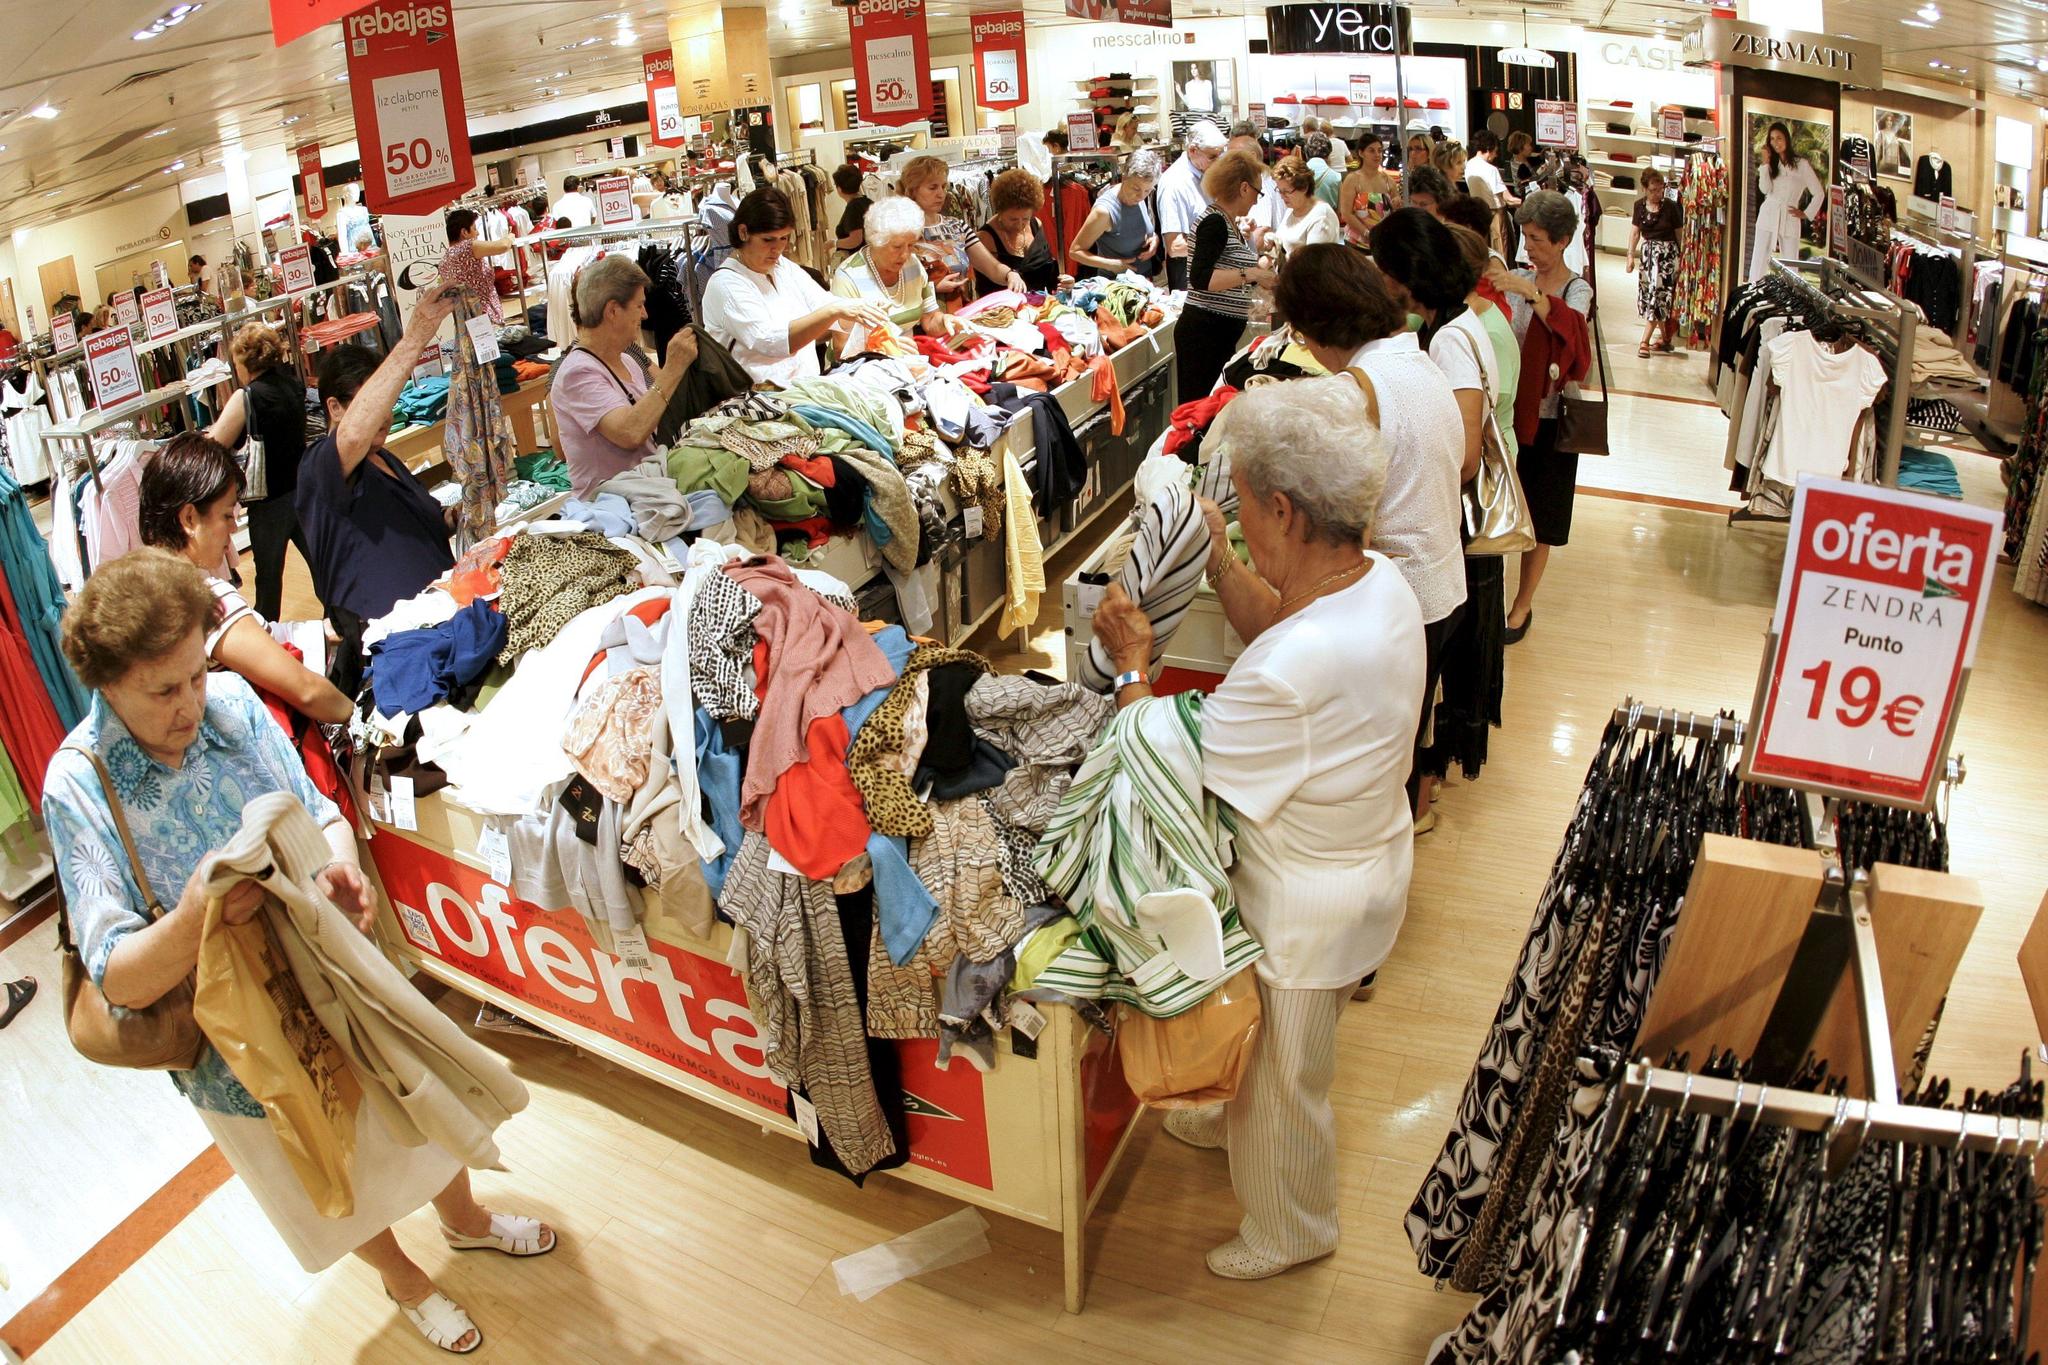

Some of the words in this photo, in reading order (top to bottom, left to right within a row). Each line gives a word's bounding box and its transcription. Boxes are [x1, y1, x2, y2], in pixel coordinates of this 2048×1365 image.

[349, 2, 448, 38] rebajas
[974, 20, 1022, 35] rebajas
[1093, 30, 1181, 48] messcalino
[868, 48, 911, 61] messcalino
[1731, 32, 1857, 71] ZERMATT
[645, 57, 672, 74] rebaj
[391, 88, 439, 105] claiborne
[876, 82, 912, 101] 50%
[599, 180, 628, 191] rebajas
[386, 228, 405, 240] NOS
[407, 221, 445, 238] ponemos
[401, 238, 411, 249] A
[411, 231, 433, 246] TU
[281, 247, 308, 261] rebajas
[391, 241, 448, 264] ALTURA
[144, 289, 170, 304] rebajas
[88, 331, 129, 353] rebajas
[100, 366, 132, 387] 50%
[1811, 512, 1973, 587] oferta
[1821, 585, 1944, 628] ZENDRA
[1844, 627, 1904, 655] Punto
[1801, 659, 1926, 738] 19€
[425, 881, 788, 1090] oferta
[462, 960, 477, 974] NO
[605, 1023, 620, 1037] LE
[625, 1032, 718, 1080] DEVOLVEMOS
[722, 1075, 741, 1090] SU
[746, 1087, 785, 1109] DINE
